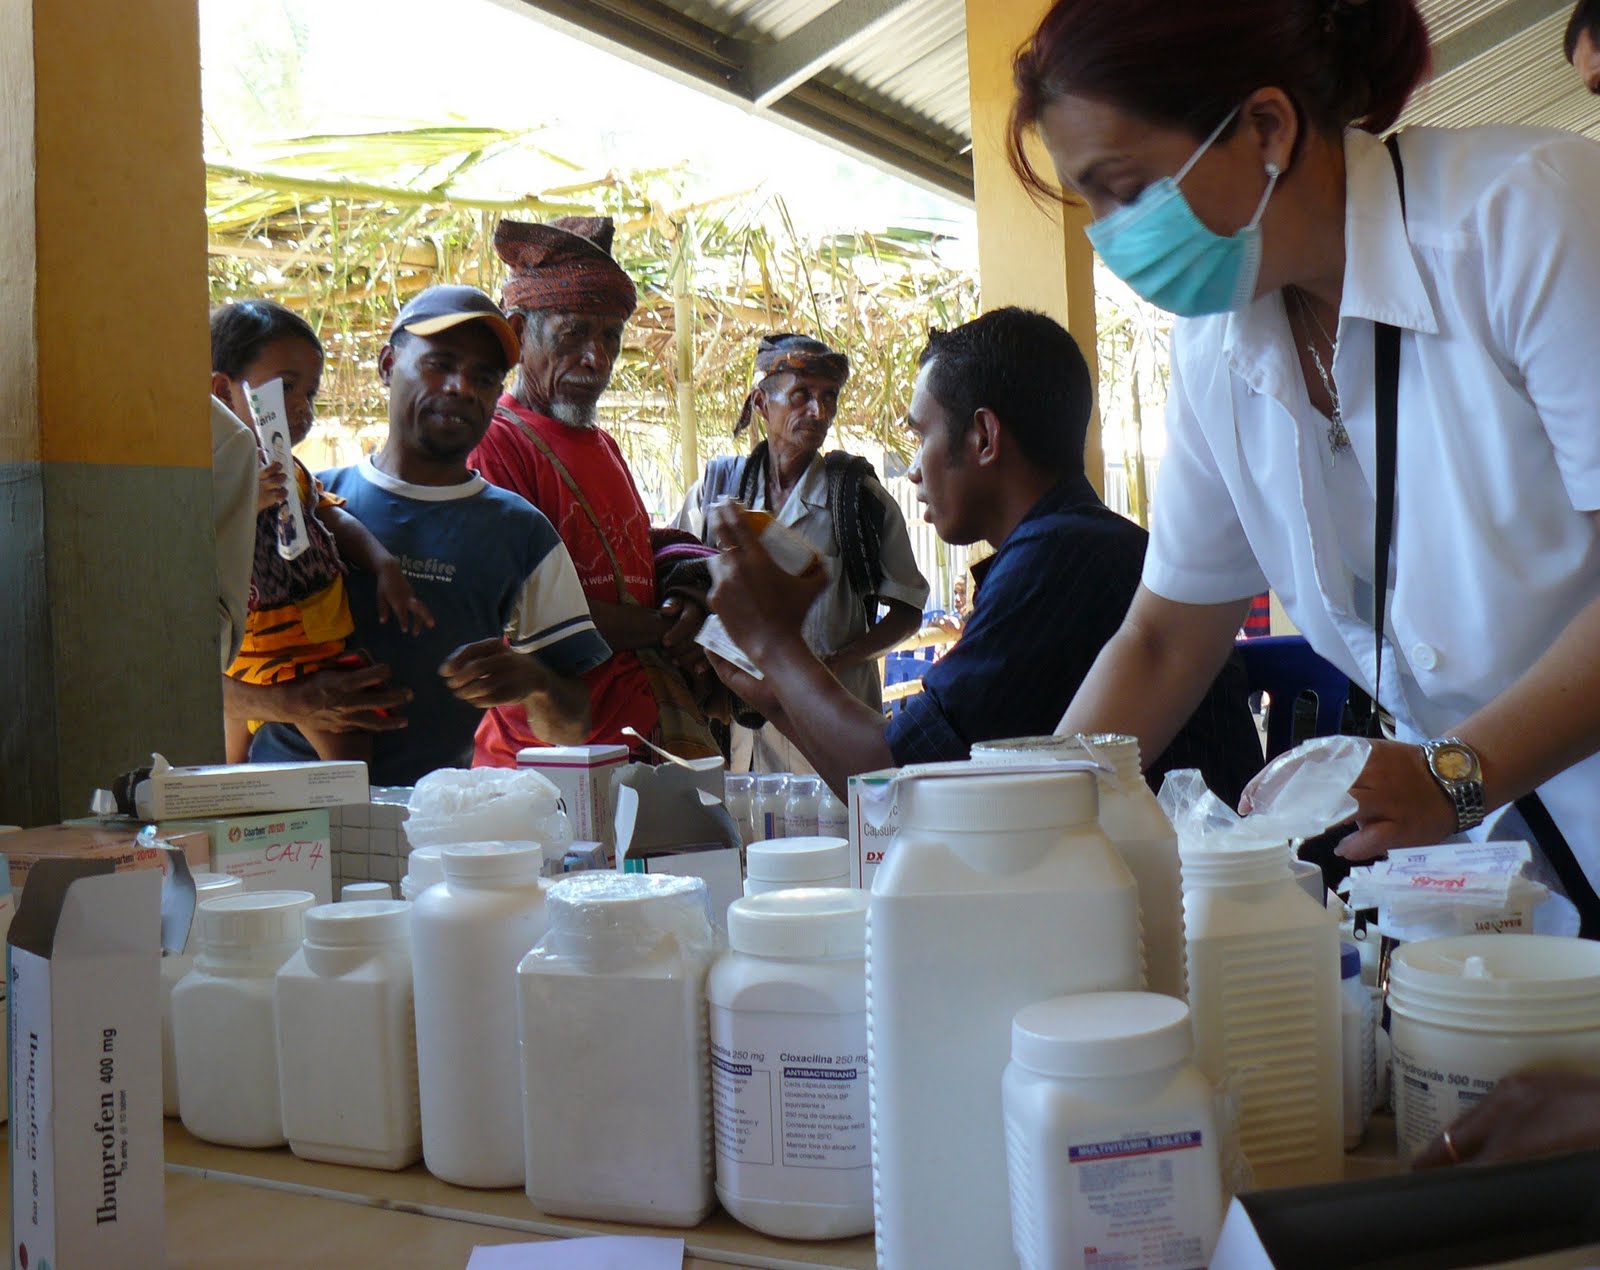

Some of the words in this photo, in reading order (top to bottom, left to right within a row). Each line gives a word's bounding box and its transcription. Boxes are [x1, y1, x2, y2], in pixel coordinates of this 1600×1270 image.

[256, 411, 277, 427] laria
[589, 574, 614, 585] WEAR
[265, 841, 312, 862] CAT
[309, 842, 323, 870] 4
[103, 1028, 117, 1052] mg
[732, 1050, 748, 1060] 250
[750, 1053, 765, 1062] mg
[779, 1053, 833, 1065] Cloxacilina
[835, 1055, 853, 1065] 250
[100, 1057, 114, 1084] 400
[785, 1068, 856, 1079] ANTIBACTERIANO
[1447, 1072, 1470, 1087] 500
[27, 1031, 39, 1161] Ibuprofen
[1151, 1132, 1193, 1147] TABLETS
[94, 1092, 122, 1227] Ibuprofen
